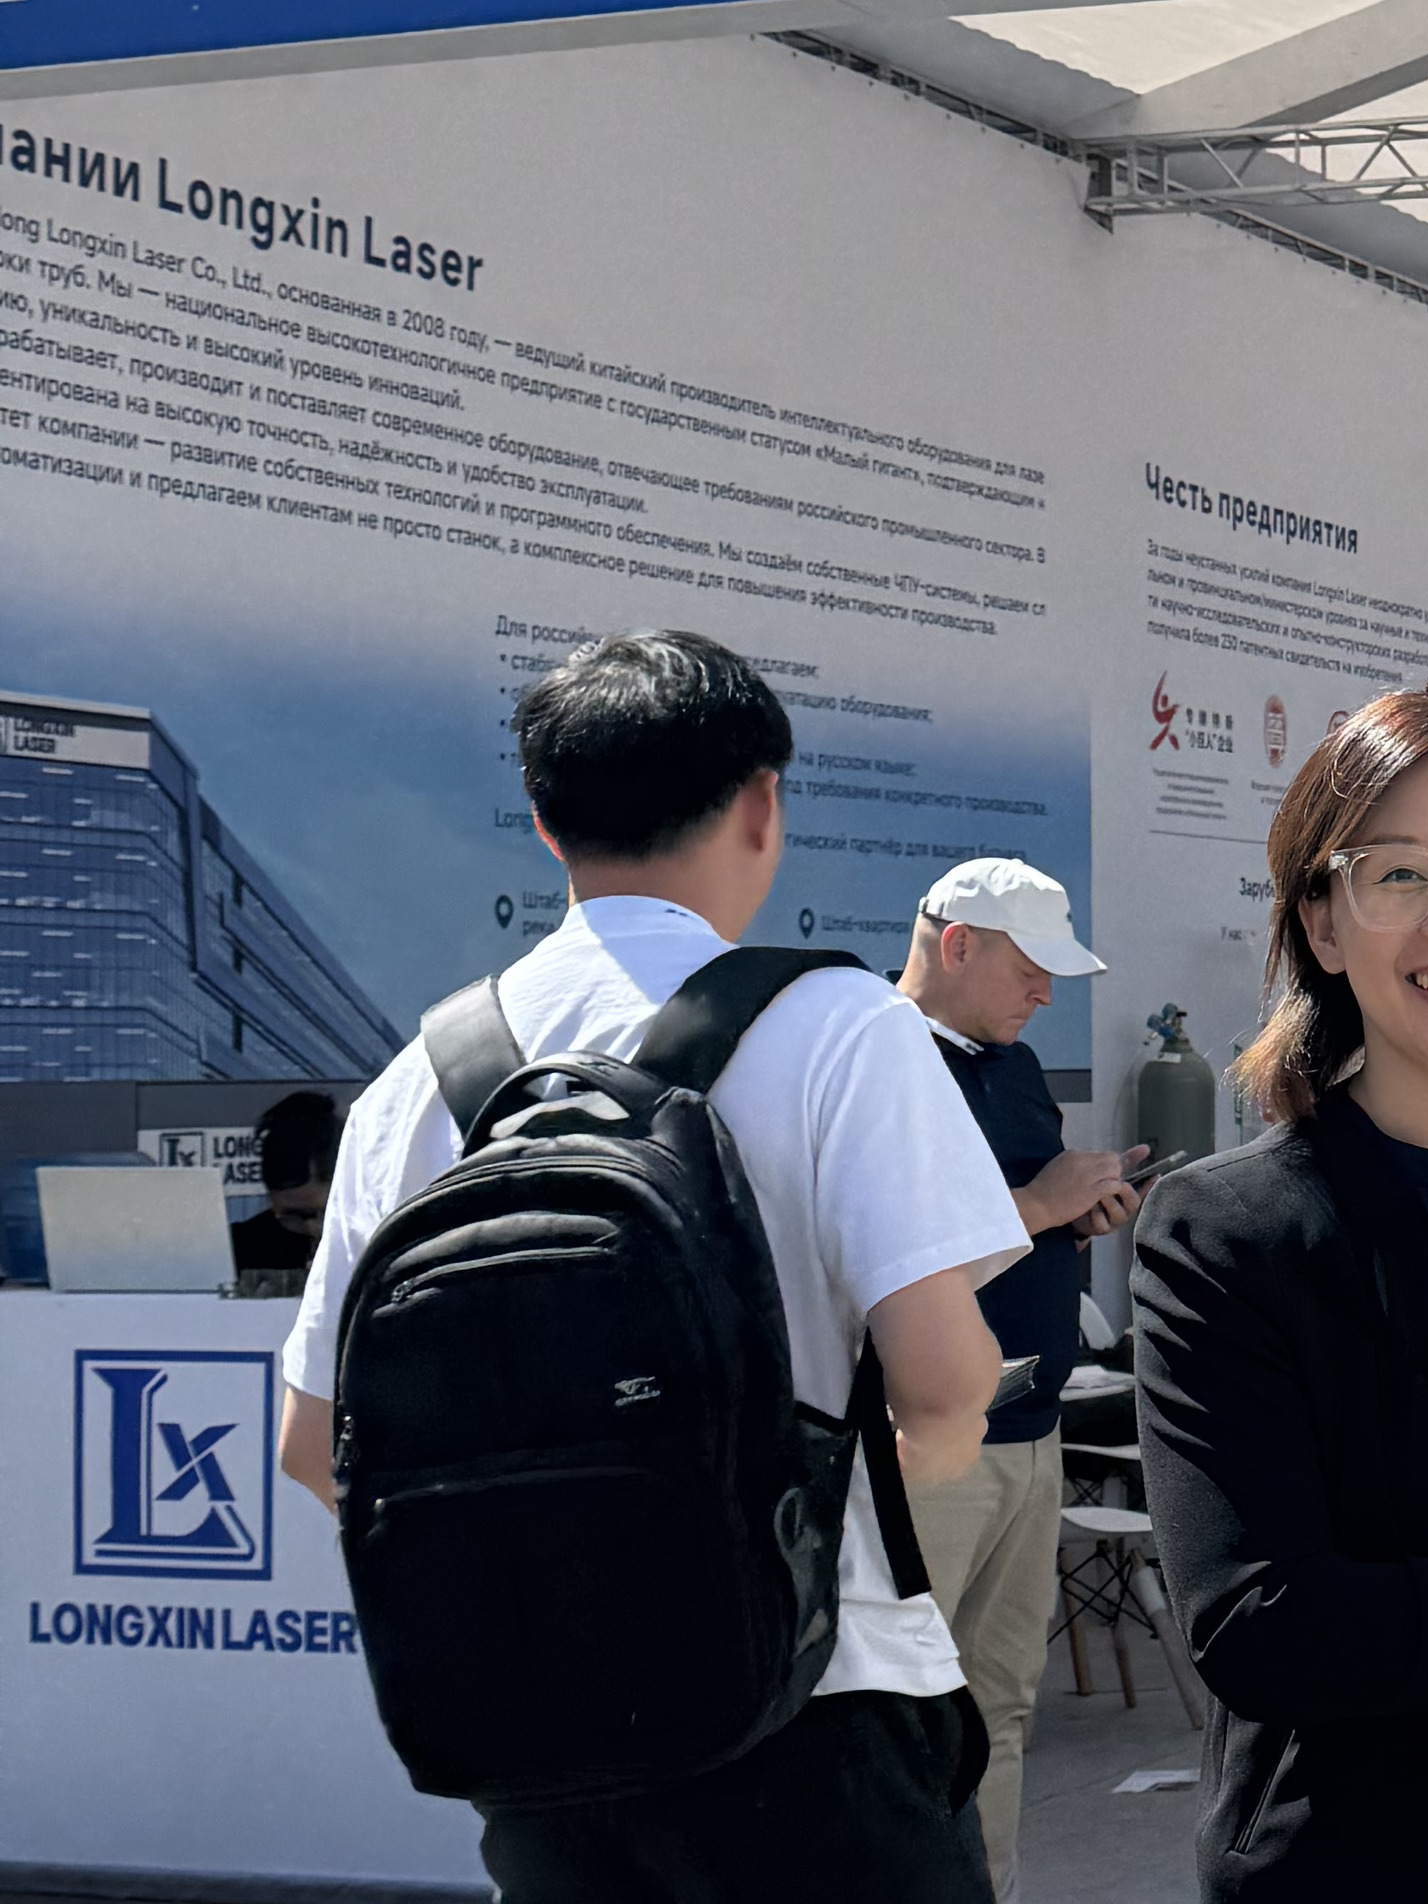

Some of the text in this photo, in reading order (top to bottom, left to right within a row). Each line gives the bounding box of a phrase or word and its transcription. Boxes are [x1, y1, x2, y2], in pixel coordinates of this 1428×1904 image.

[158, 158, 348, 258] Longxin
[364, 216, 482, 291] Laser
[1146, 463, 1358, 553] Честь предприятия
[29, 1601, 359, 1656] LONGXIN LASER
